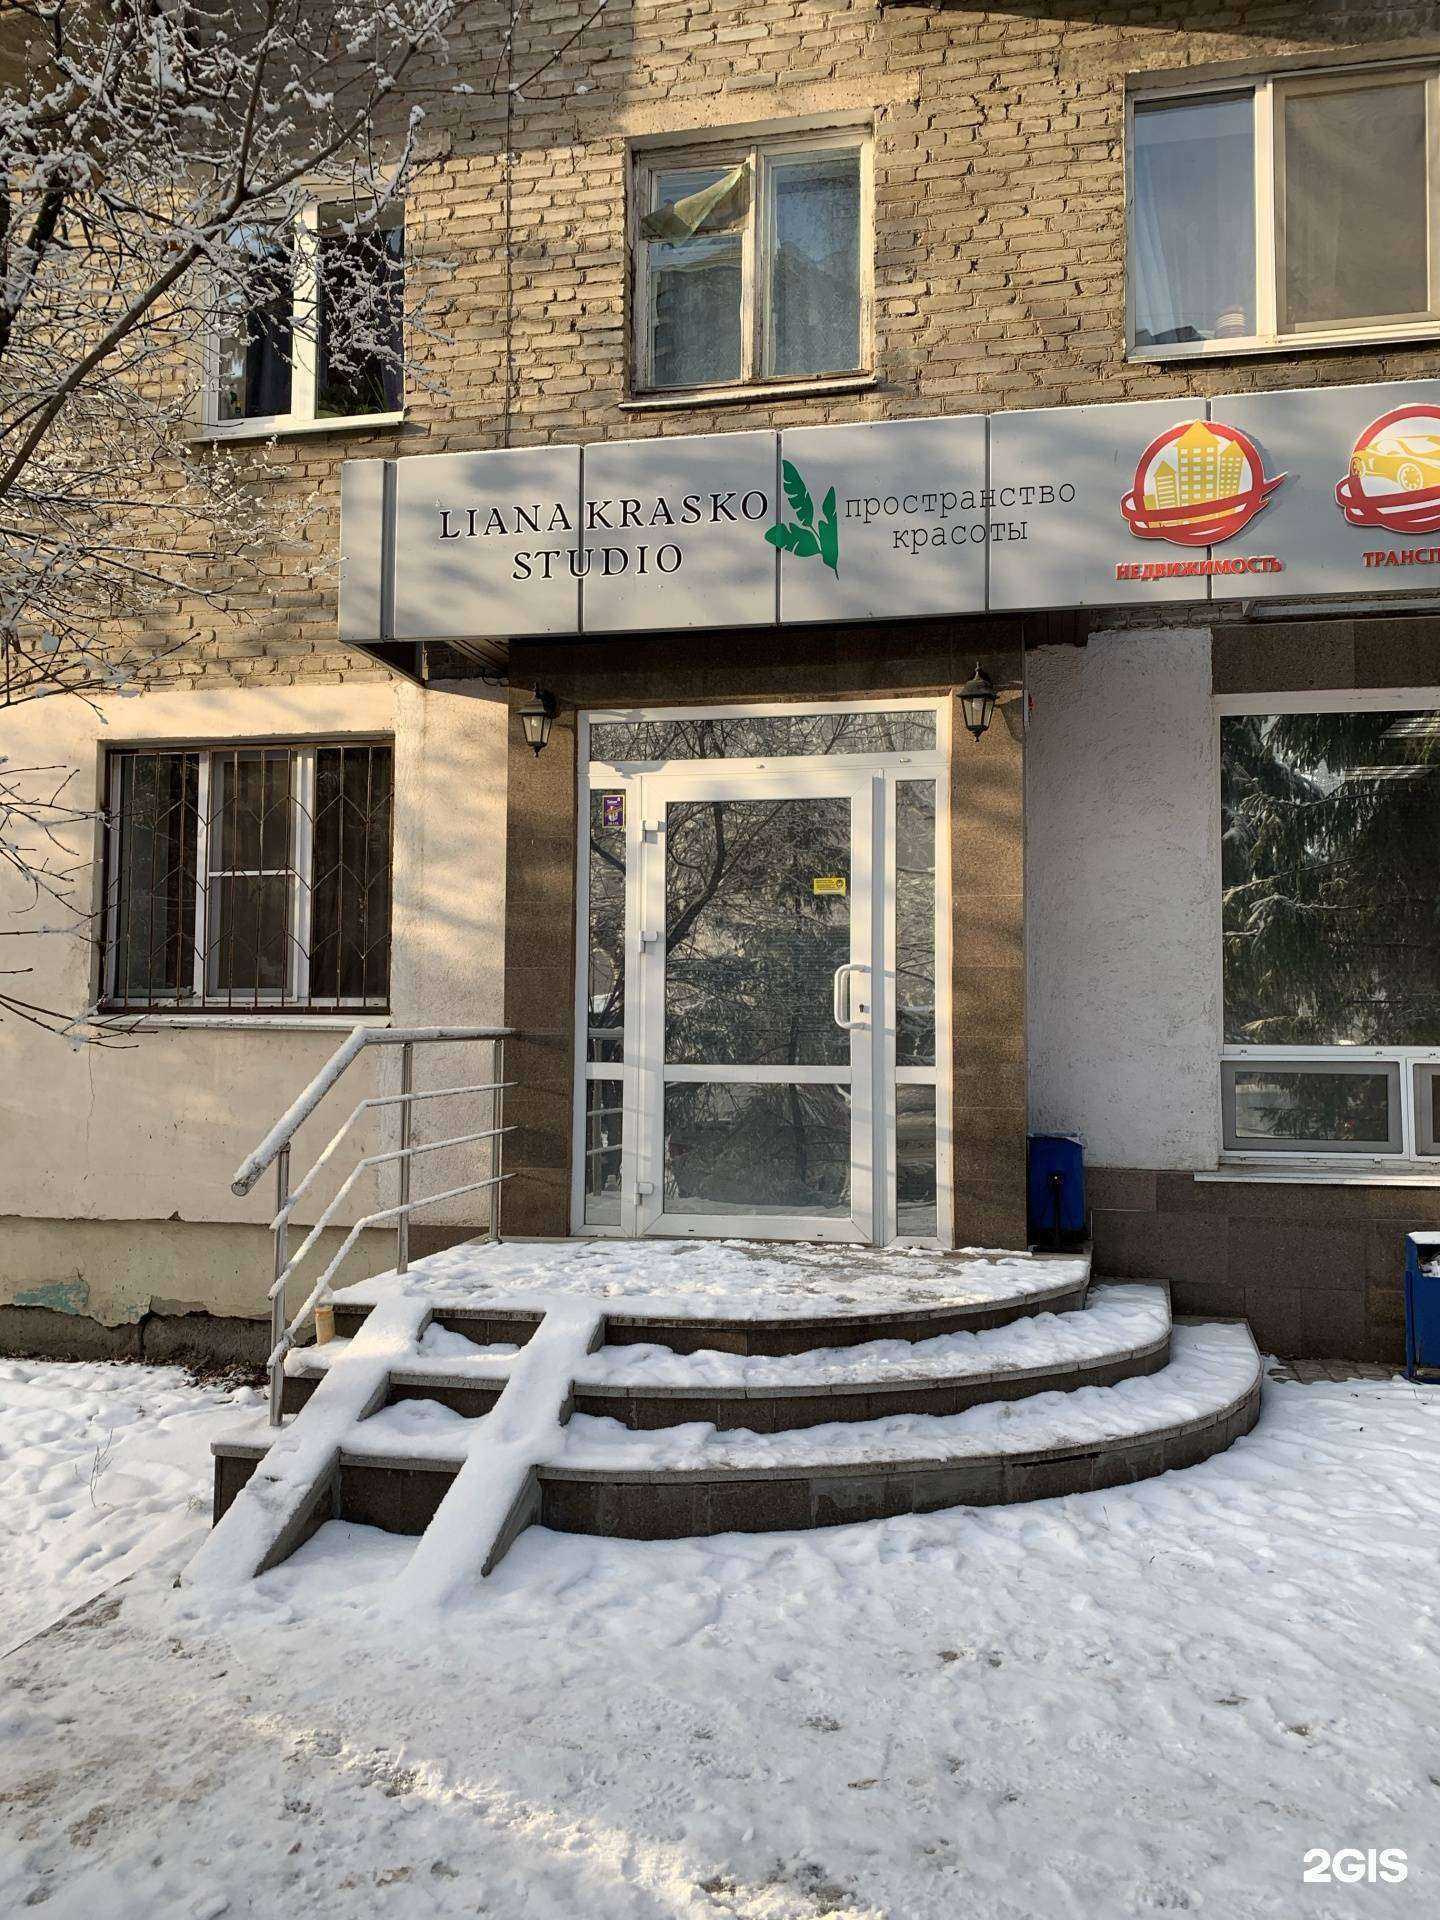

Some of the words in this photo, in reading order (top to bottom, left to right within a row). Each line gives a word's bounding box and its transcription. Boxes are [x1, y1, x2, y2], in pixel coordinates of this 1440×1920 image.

[439, 502, 573, 540] LIANA
[585, 490, 769, 530] KRASKO
[845, 483, 1076, 524] пространство
[892, 521, 1028, 554] красоты
[511, 544, 683, 581] STUDIO
[1115, 555, 1282, 581] НЕДВИЖИМОСТЬ
